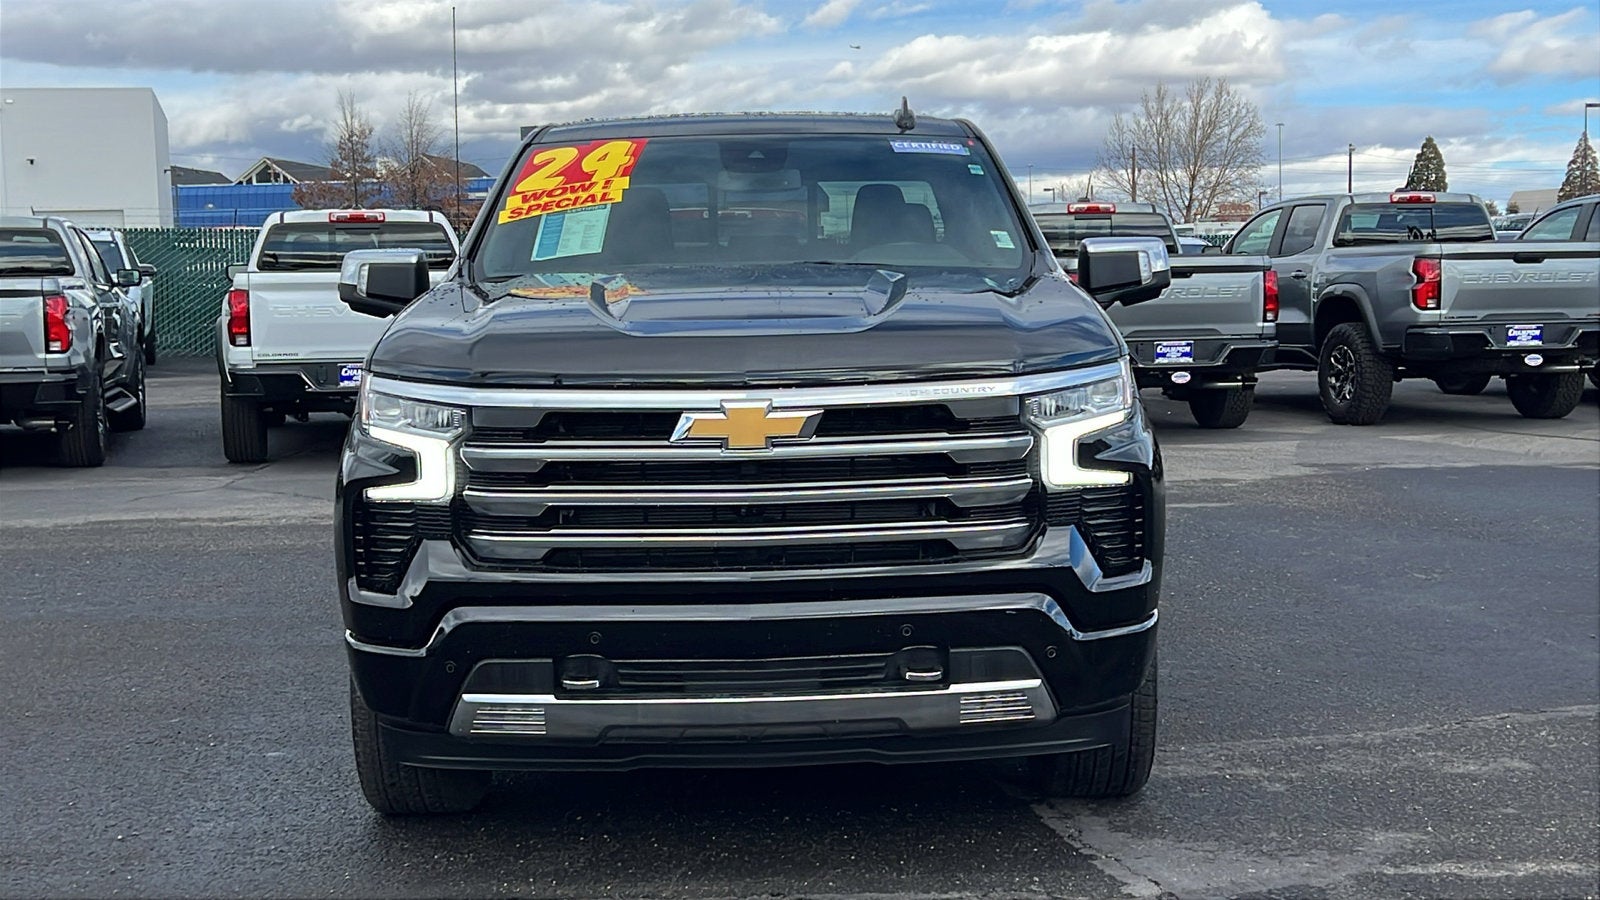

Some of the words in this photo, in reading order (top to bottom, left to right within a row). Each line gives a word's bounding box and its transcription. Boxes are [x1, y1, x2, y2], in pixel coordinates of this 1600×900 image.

[894, 142, 960, 151] CERTIFIED
[515, 141, 635, 192] 24
[507, 191, 616, 220] SPECIAL
[1462, 271, 1595, 284] CHEVROLET
[1507, 329, 1541, 337] CHAMPION
[933, 385, 996, 396] COUNTRY
